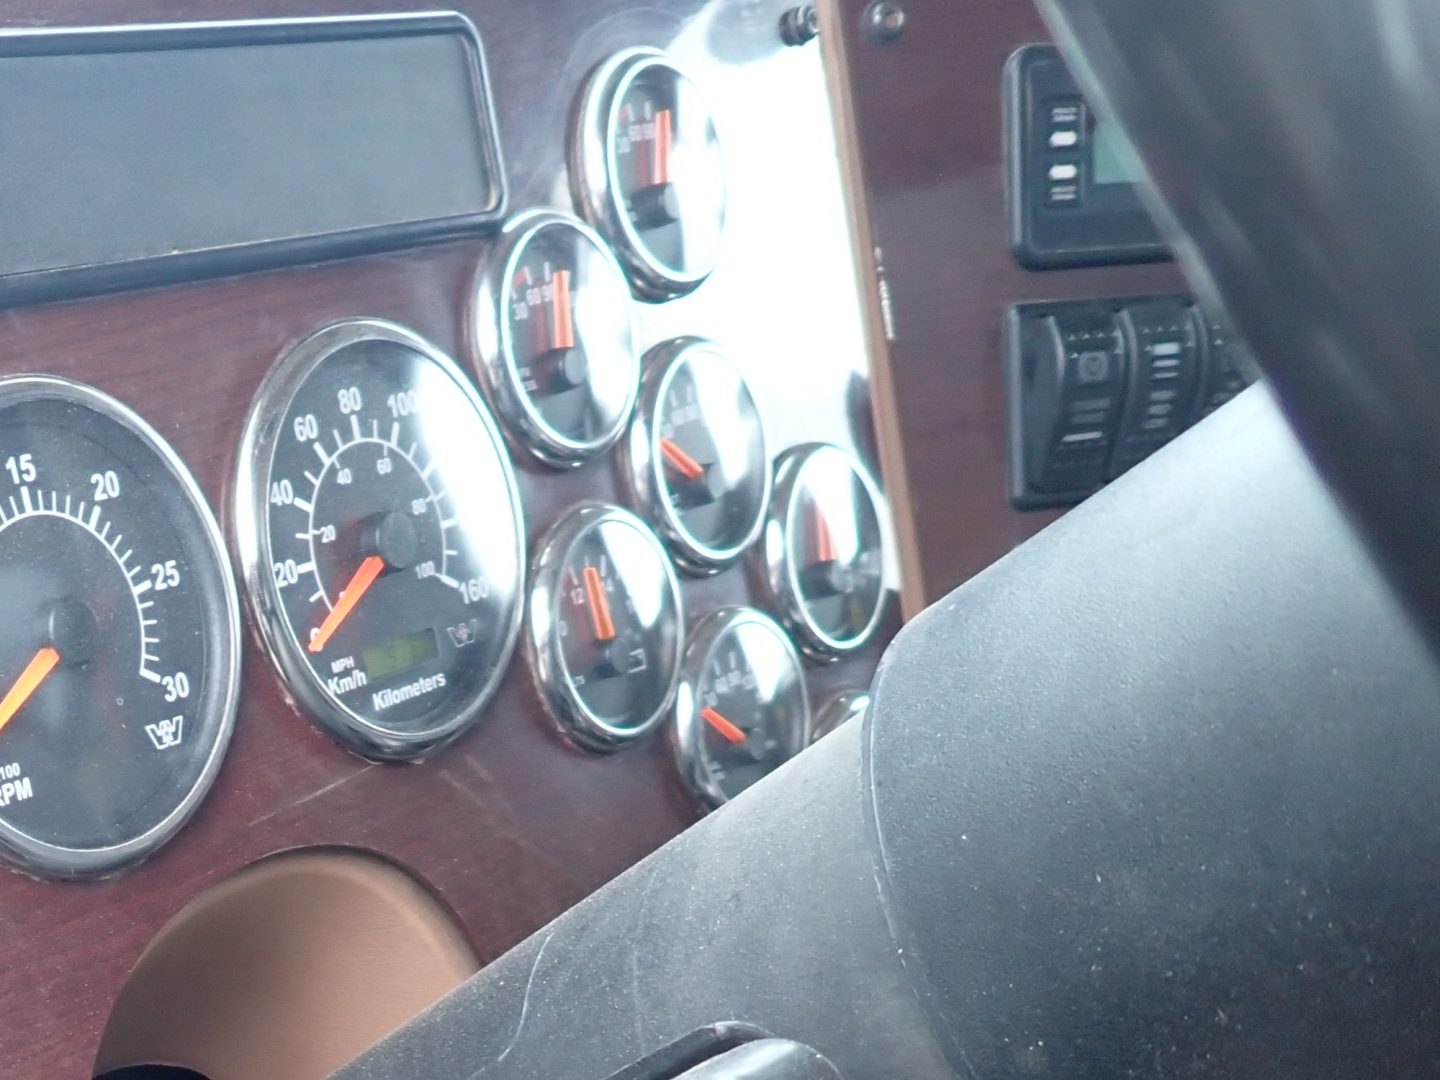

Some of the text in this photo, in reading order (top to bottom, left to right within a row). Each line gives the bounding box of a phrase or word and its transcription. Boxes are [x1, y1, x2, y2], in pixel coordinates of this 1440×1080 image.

[337, 386, 362, 413] 80
[387, 391, 418, 418] 100
[293, 414, 318, 442] 60
[5, 453, 37, 484] 15
[336, 467, 353, 486] 40
[376, 457, 393, 475] 60
[90, 471, 120, 500] 20
[269, 479, 294, 506] 40
[411, 498, 427, 515] 80
[321, 525, 336, 543] 20
[151, 560, 181, 591] 25
[273, 559, 298, 588] 20
[415, 560, 436, 579] 100
[460, 576, 491, 604] 160
[331, 656, 355, 674] MPH
[161, 672, 189, 702] 30
[328, 669, 367, 695] Km/h
[372, 673, 446, 711] Kilometers
